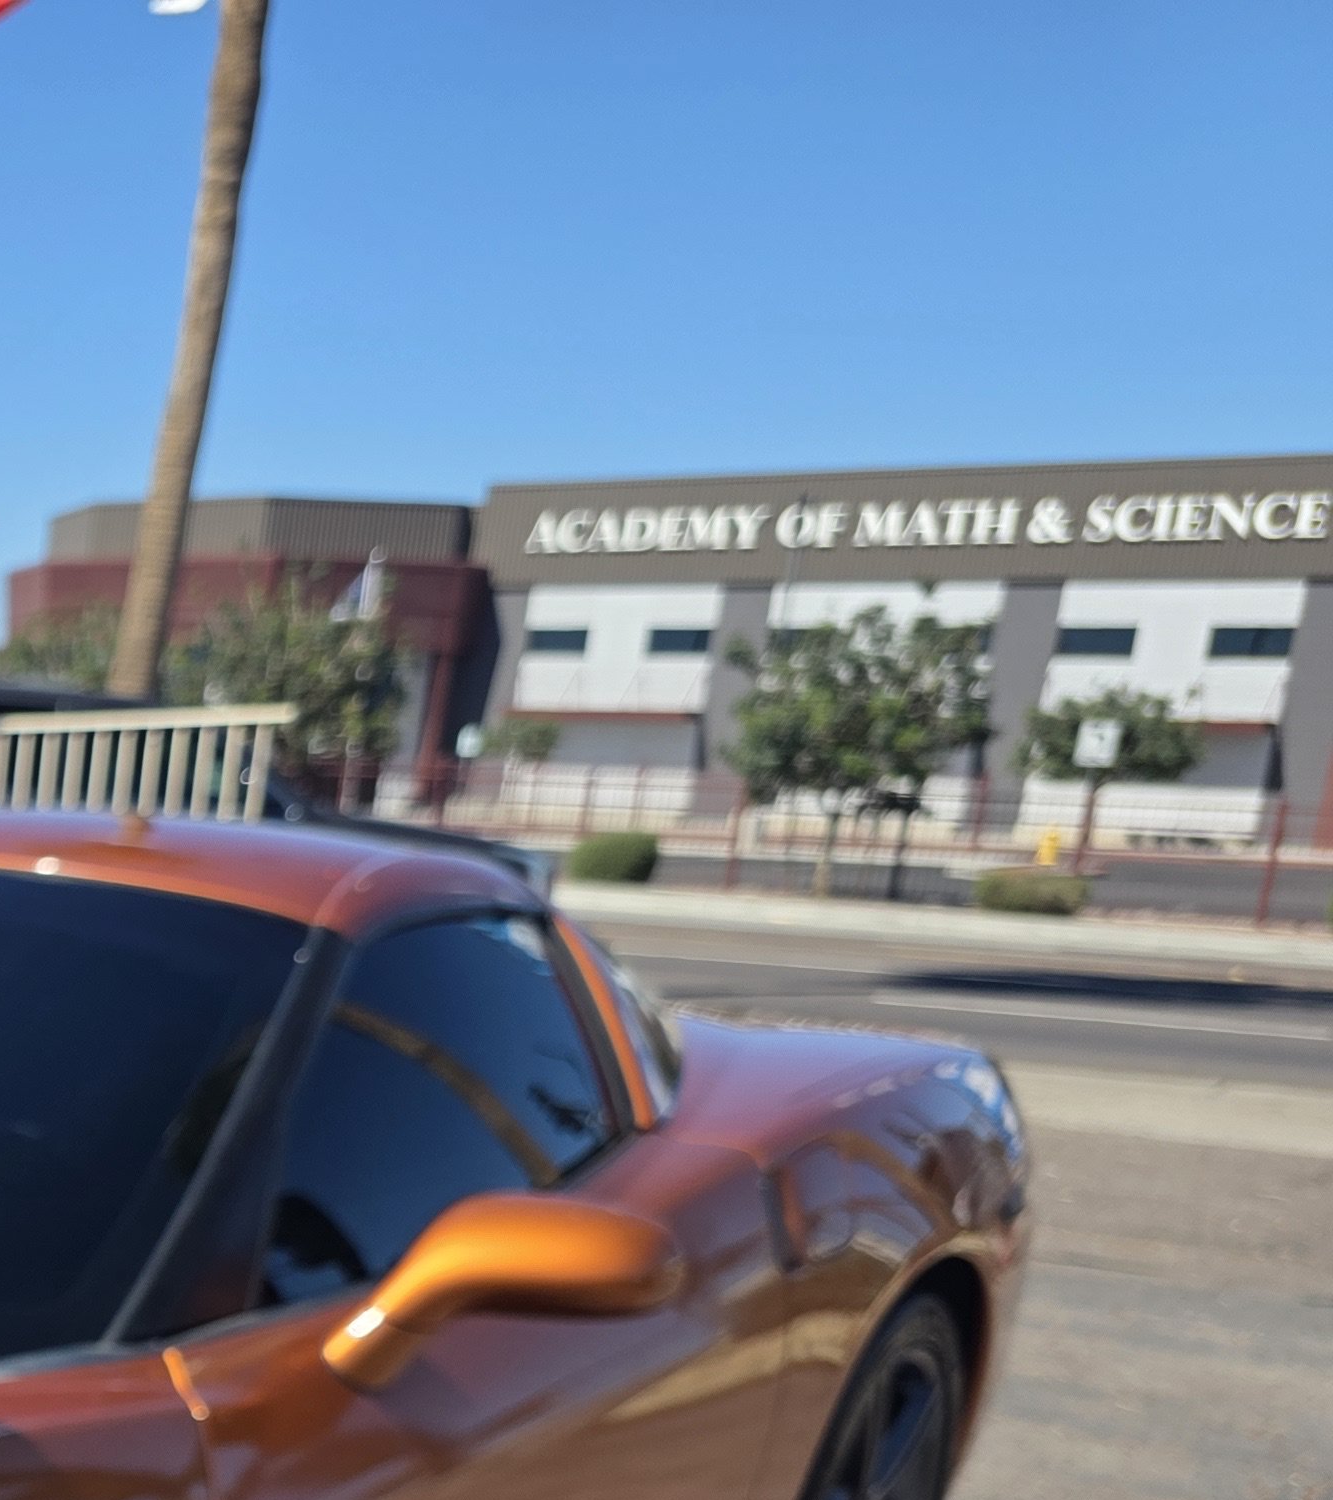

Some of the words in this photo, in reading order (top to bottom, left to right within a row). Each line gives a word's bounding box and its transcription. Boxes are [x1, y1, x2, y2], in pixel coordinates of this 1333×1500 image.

[523, 504, 773, 554] ACADEMY
[774, 502, 849, 549] OF
[851, 498, 1022, 547] MATH
[1026, 497, 1075, 545] &
[1081, 491, 1331, 543] SCIENCE
